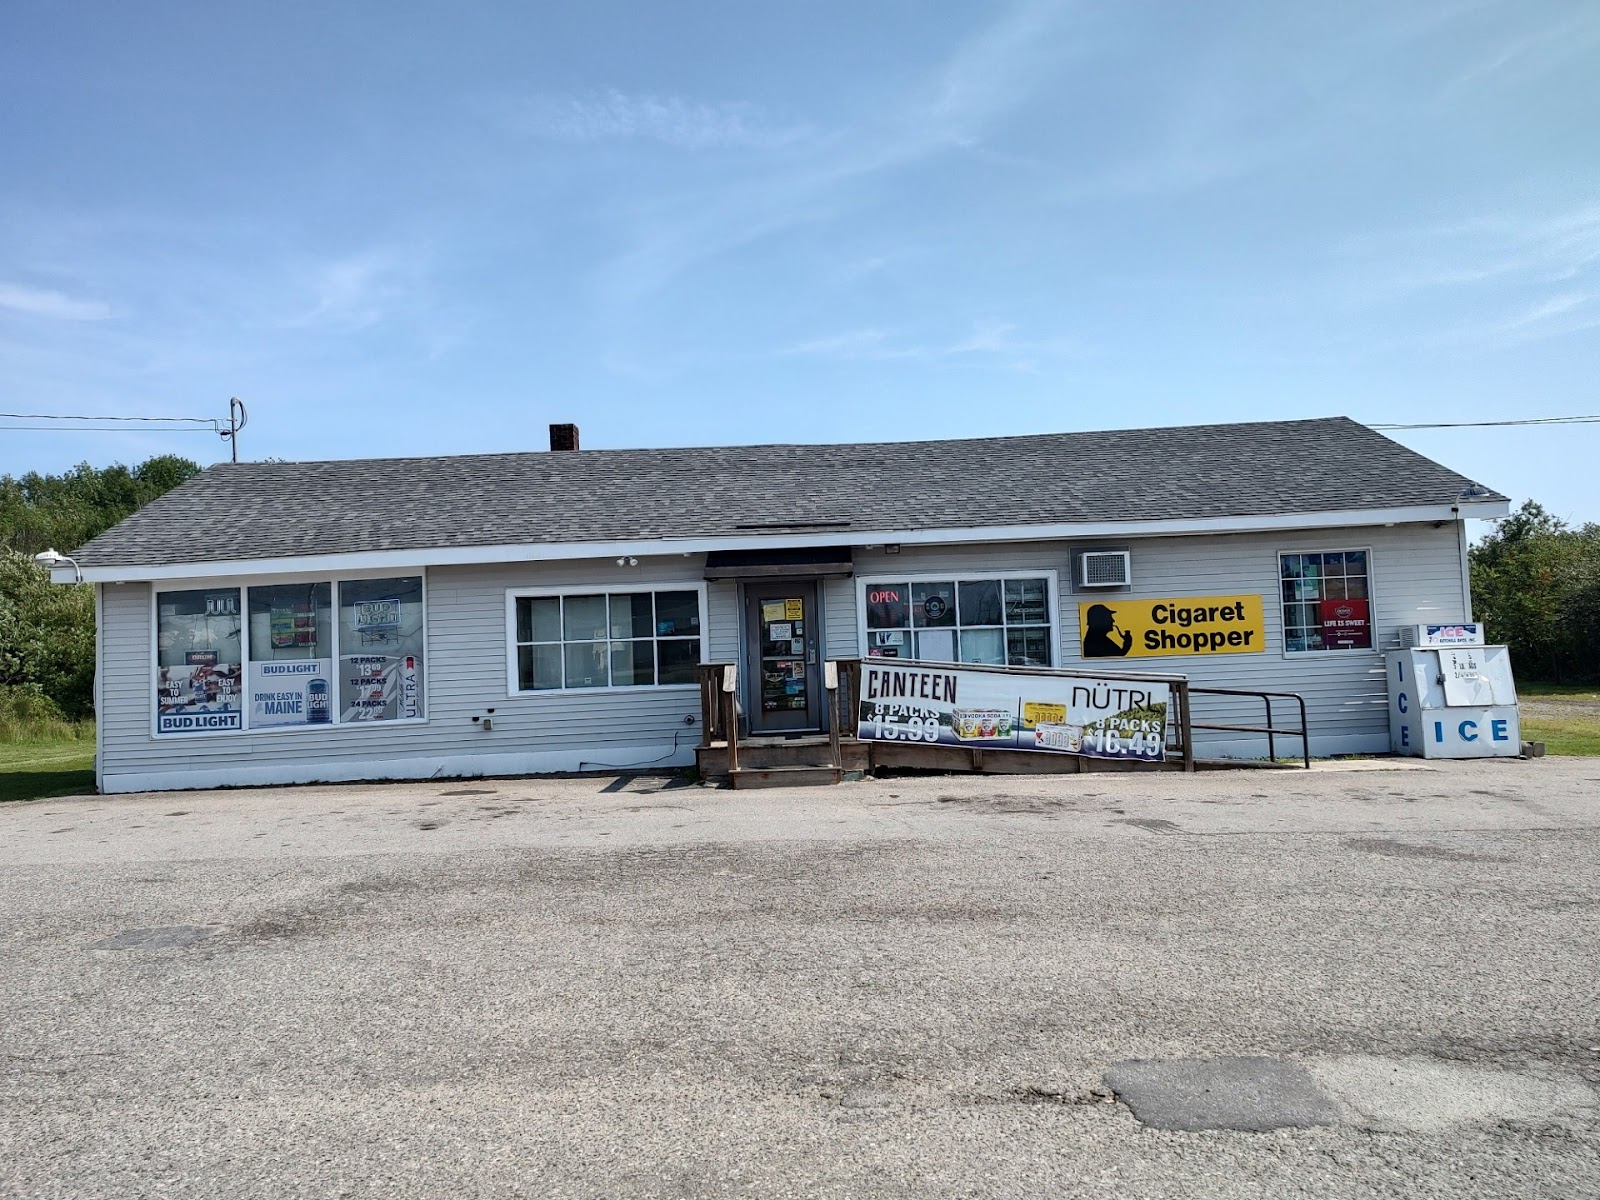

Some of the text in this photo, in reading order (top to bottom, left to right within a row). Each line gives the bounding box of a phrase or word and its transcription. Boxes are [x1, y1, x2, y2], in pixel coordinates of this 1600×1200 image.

[870, 591, 899, 604] OPEN
[361, 602, 392, 614] BUD
[1151, 601, 1245, 628] Cigaret
[1440, 626, 1464, 638] ICE
[1144, 629, 1254, 652] Shopper
[360, 656, 387, 664] PACKS
[263, 664, 318, 674] BUD LIGHT
[165, 681, 183, 689] EASY
[218, 678, 235, 687] EASY
[360, 677, 387, 685] PACKS
[868, 670, 958, 704] CANTEEN
[170, 688, 179, 697] TO
[222, 686, 231, 694] TO
[406, 674, 416, 718] ULTRA
[160, 696, 189, 705] SUMMER
[216, 693, 237, 702] ENJOY
[254, 691, 303, 702] DRINK EASY IN
[309, 693, 328, 701] BUD
[265, 700, 303, 715] MAINE
[361, 700, 387, 708] PACKS
[874, 703, 883, 715] 8
[889, 703, 940, 719] PACKS
[163, 715, 237, 729] BUD LIGHT
[867, 713, 940, 743] $15.99
[1096, 717, 1161, 733] 8 PACKS
[1434, 719, 1509, 742] ICE
[1087, 728, 1161, 756] $16.49
